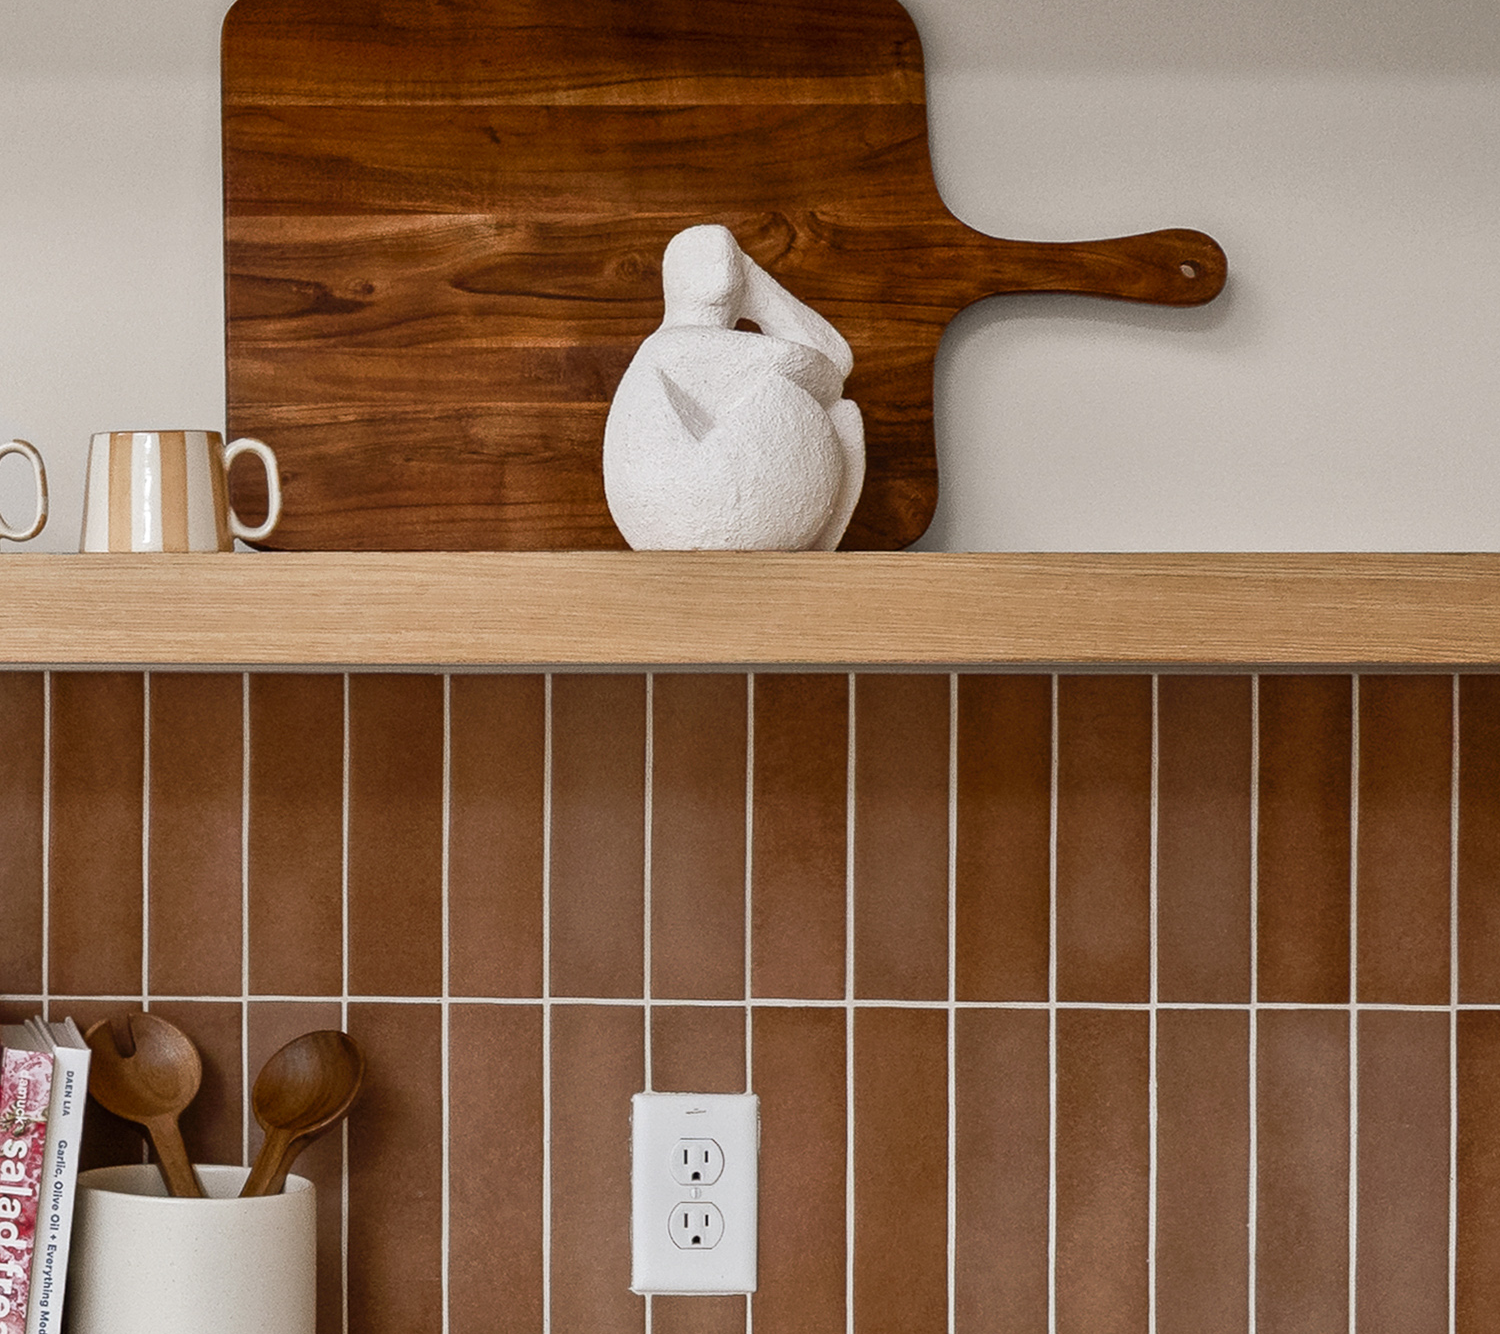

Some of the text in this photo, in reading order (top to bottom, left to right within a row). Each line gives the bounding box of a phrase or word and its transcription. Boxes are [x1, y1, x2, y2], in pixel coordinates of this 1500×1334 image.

[62, 1070, 75, 1116] DAEN LIA
[54, 1140, 67, 1177] Garlic,
[51, 1181, 63, 1211] Olive
[50, 1213, 60, 1230] Oil
[39, 1244, 57, 1307] Everything
